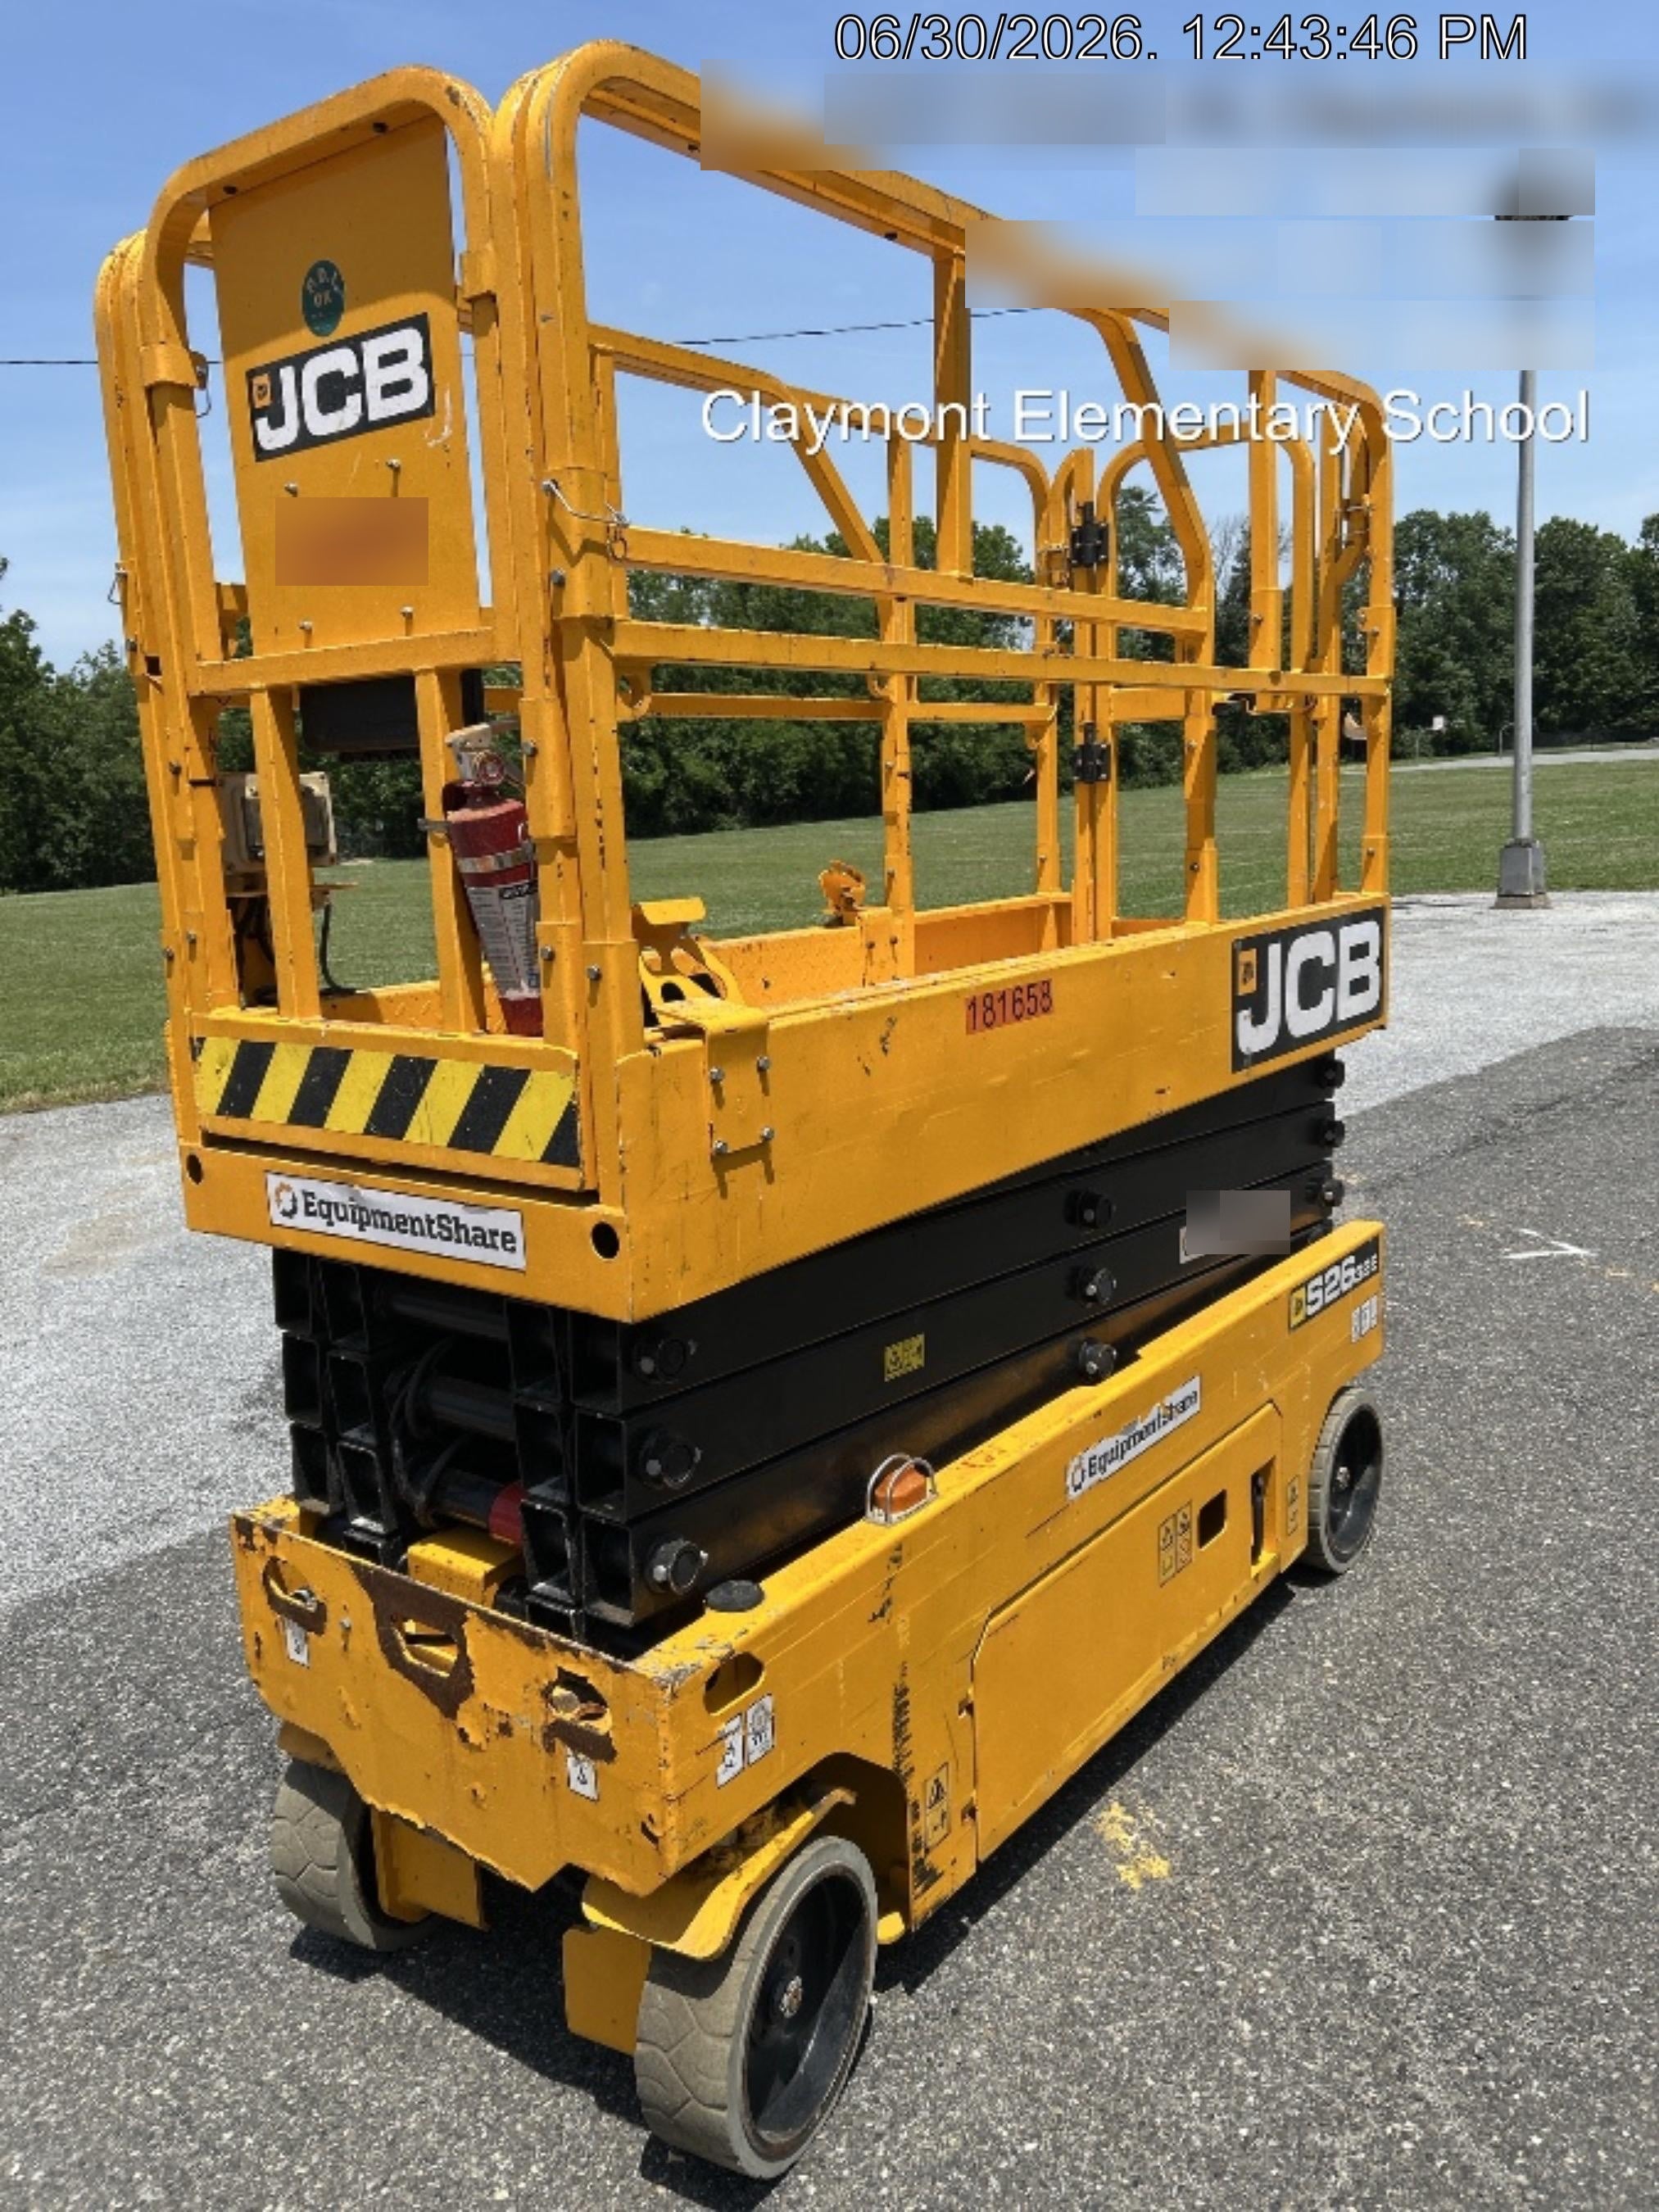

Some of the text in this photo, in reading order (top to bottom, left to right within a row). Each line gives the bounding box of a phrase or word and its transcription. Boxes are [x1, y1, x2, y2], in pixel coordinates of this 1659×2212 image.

[256, 327, 429, 451] JCB
[968, 979, 1053, 1031] 181658
[1237, 920, 1380, 1055] JCB
[301, 1189, 517, 1253] EquipmentShare
